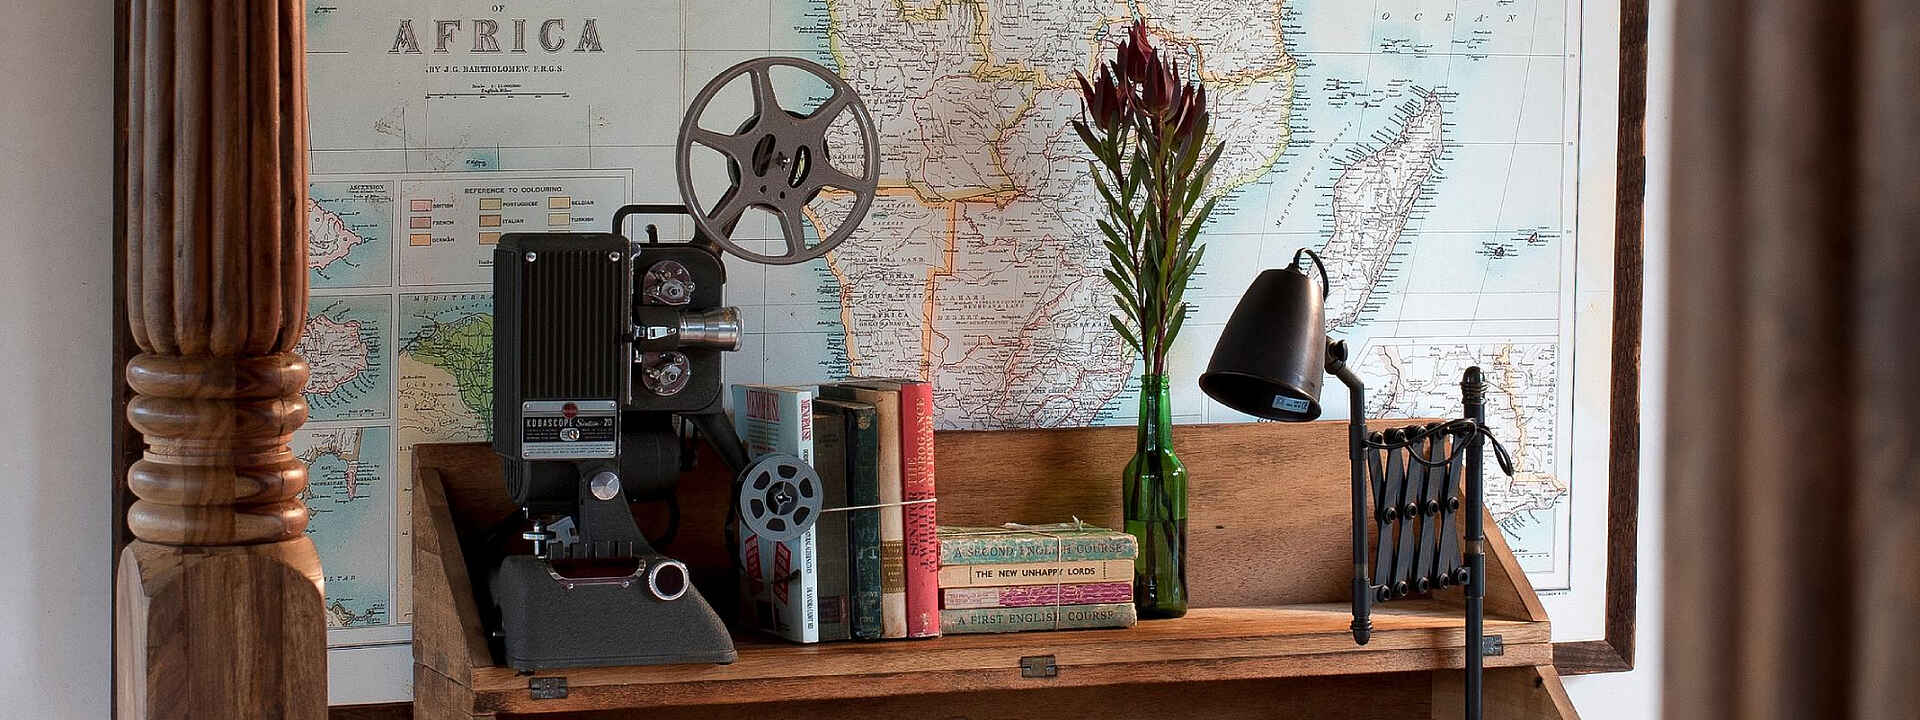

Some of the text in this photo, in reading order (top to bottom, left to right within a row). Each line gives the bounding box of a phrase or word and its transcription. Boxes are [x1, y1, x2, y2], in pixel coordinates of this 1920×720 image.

[1381, 12, 1518, 23] OCEAN
[387, 18, 606, 55] AFRICA
[430, 65, 441, 73] BY
[526, 418, 574, 427] KODASCOPE
[800, 399, 812, 441] MENOPAUSE
[917, 398, 927, 486] ARROGANCE
[926, 416, 936, 486] OF POWER
[907, 457, 918, 487] THE
[909, 491, 919, 556] SENATOR
[917, 491, 928, 557] WILLIAM
[927, 490, 937, 573] FULBRIGHT
[953, 544, 1122, 558] A SECOND ENGLIH COURSE
[1022, 568, 1063, 577] UNHAPPY
[1068, 567, 1096, 575] LORDS
[958, 610, 1113, 625] A FIRST ENGLISH COURSE
